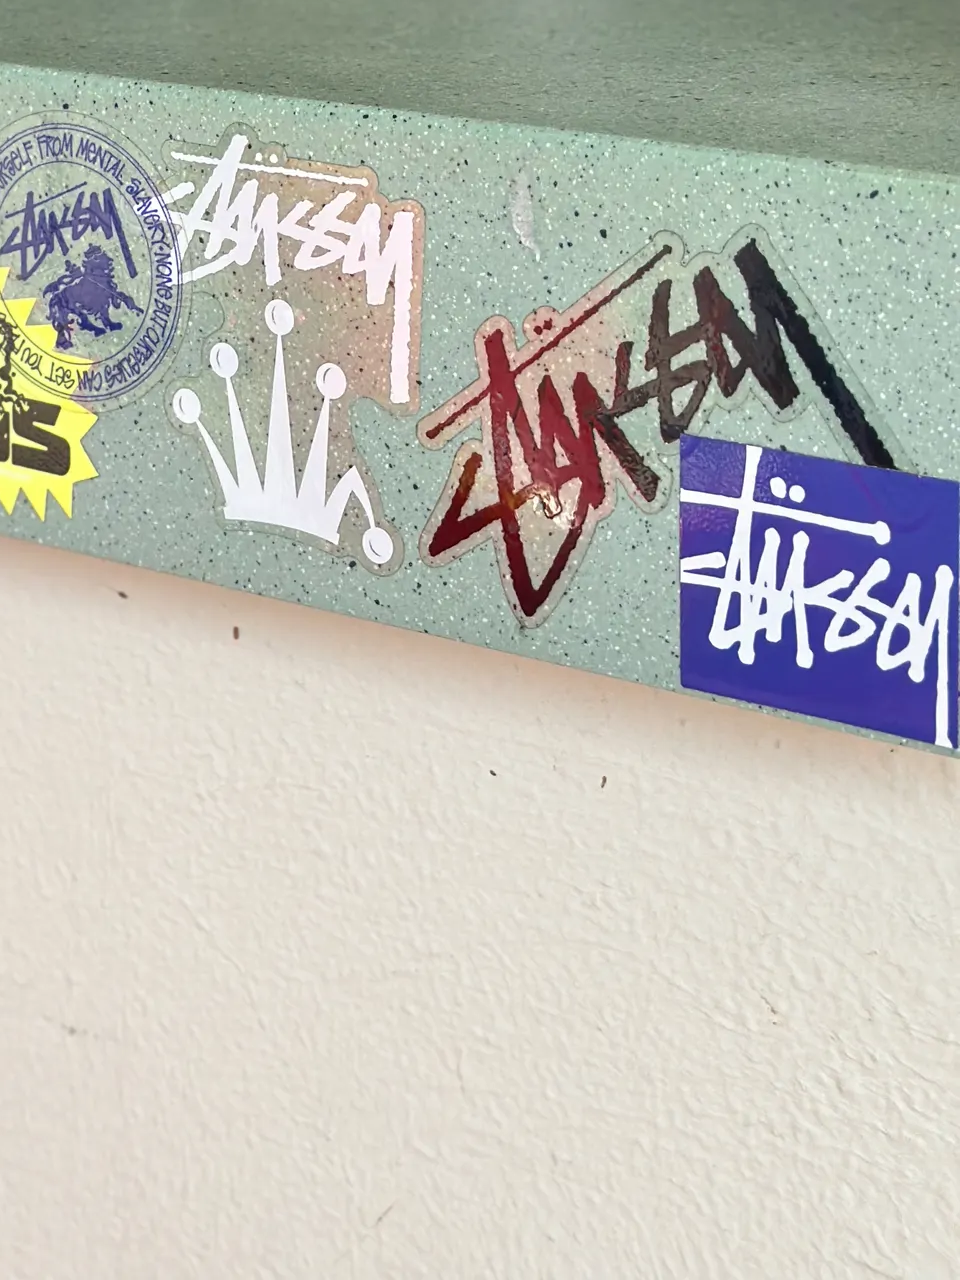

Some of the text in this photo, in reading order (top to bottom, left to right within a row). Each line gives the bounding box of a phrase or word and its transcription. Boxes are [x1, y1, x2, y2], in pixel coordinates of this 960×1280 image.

[36, 133, 73, 160] FROM
[20, 347, 43, 377] YOU
[76, 368, 103, 392] CAN
